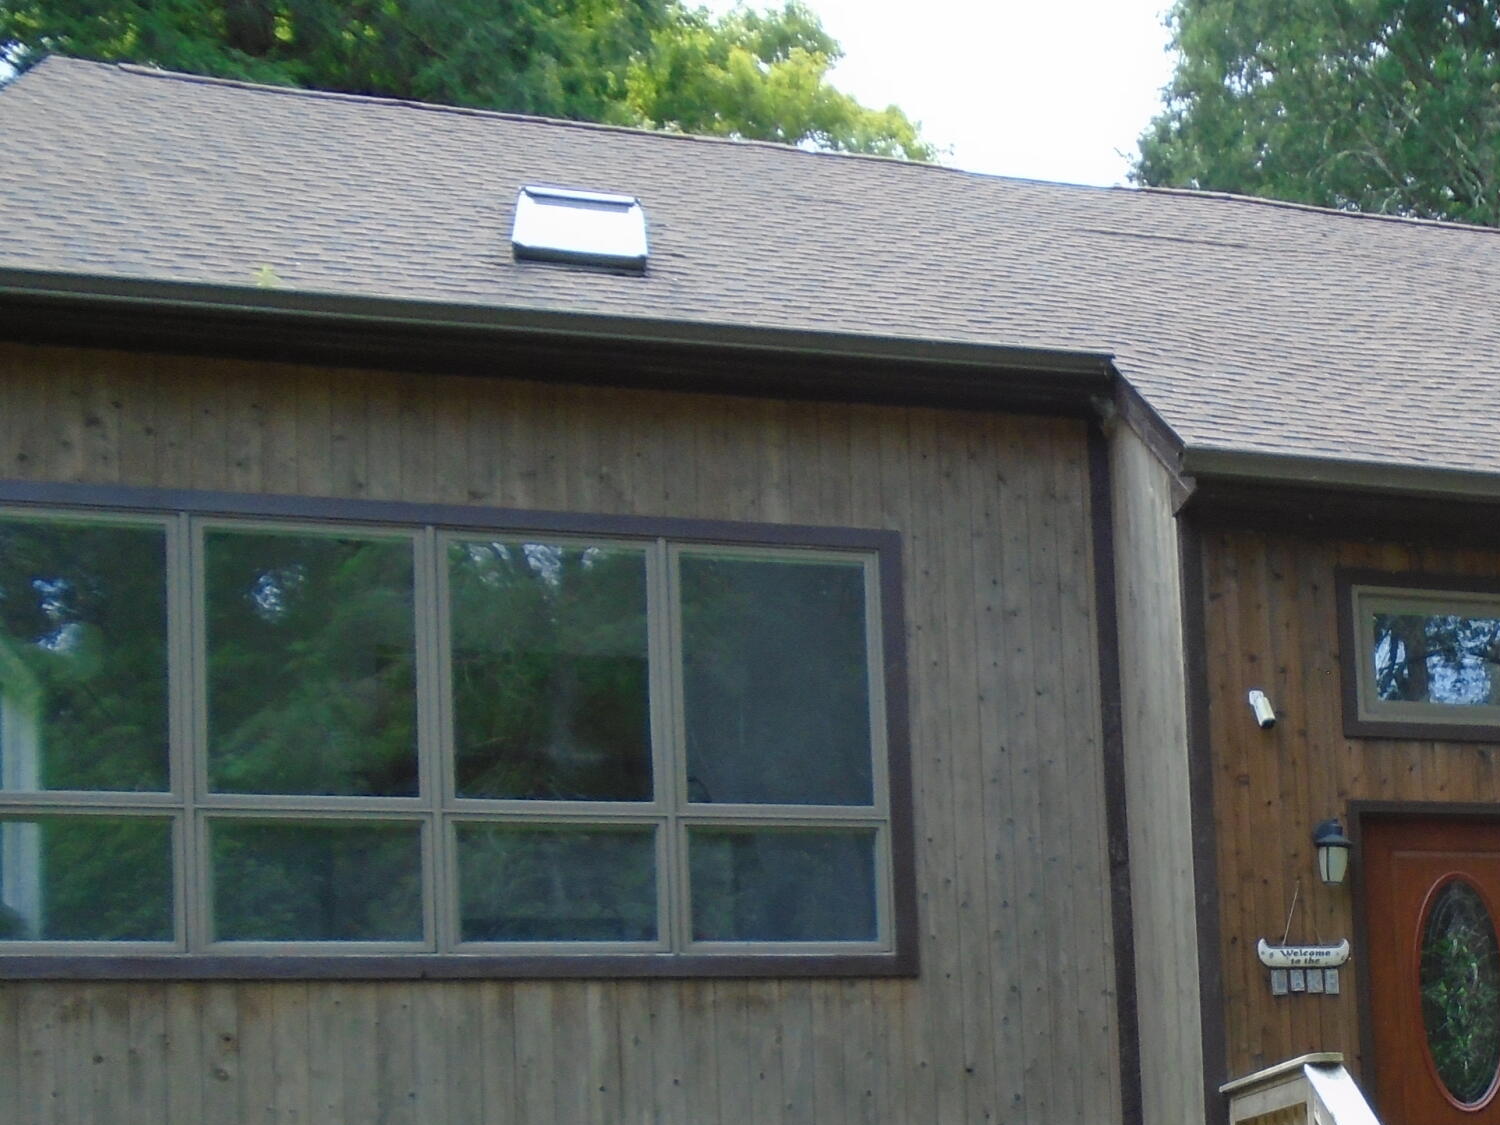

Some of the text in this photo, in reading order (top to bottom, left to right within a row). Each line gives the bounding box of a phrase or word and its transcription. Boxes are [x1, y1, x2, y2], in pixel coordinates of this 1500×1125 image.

[1280, 949, 1331, 957] Welcome
[1290, 957, 1321, 965] to the
